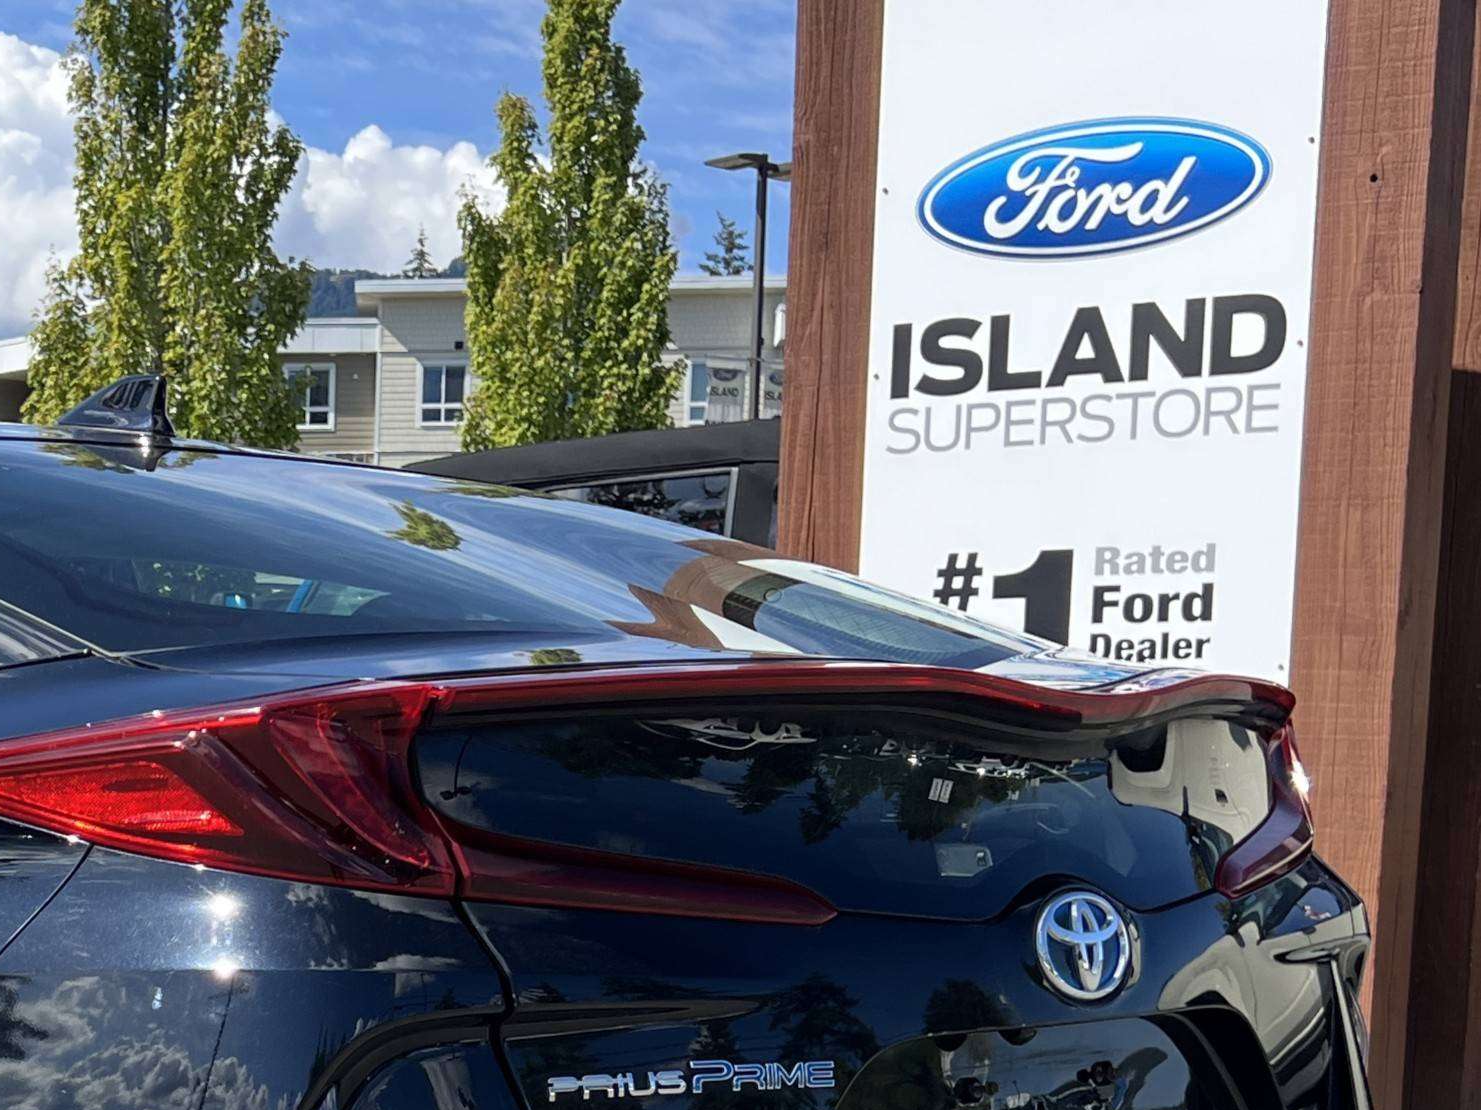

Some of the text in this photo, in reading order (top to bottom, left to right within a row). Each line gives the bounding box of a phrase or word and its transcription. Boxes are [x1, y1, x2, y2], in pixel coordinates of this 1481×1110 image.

[983, 141, 1197, 239] Ford
[890, 294, 1287, 399] ISLAND
[886, 383, 1281, 454] SUPERSTORE
[1094, 543, 1216, 576] Rated
[1091, 582, 1214, 624] Ford
[1089, 632, 1210, 664] Dealer
[547, 1059, 835, 1102] PRIUS PRIME
